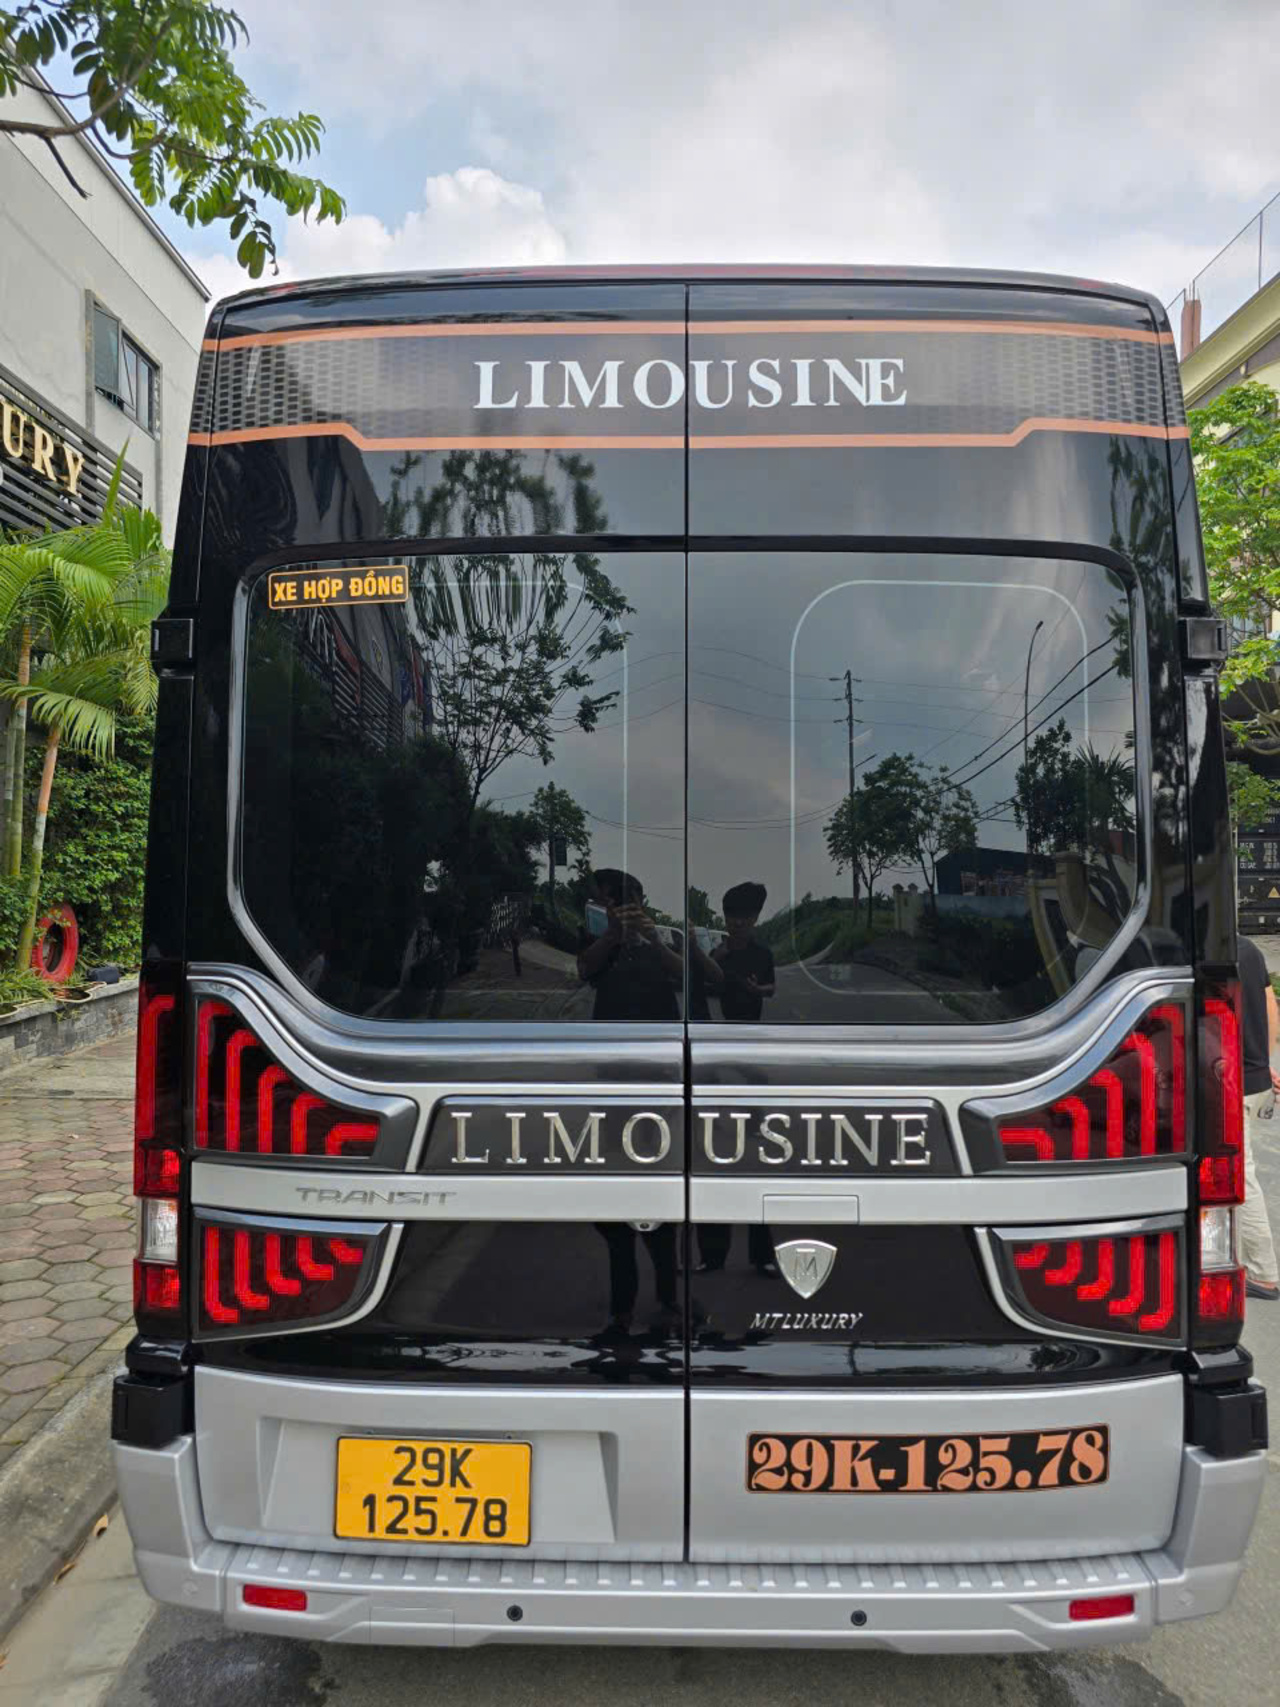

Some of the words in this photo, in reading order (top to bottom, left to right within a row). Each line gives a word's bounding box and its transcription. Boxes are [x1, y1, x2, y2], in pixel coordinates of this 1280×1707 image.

[473, 357, 908, 409] LIMOUSINE
[274, 580, 298, 603] XE
[303, 576, 344, 603] HỢP
[450, 1111, 932, 1167] LIMOUSINE
[296, 1187, 457, 1206] TRANSIT
[749, 1311, 864, 1330] MTLUXURY
[392, 1445, 474, 1490] 29K
[751, 1429, 1106, 1491] 29K-125.78
[362, 1493, 508, 1538] 125.78
